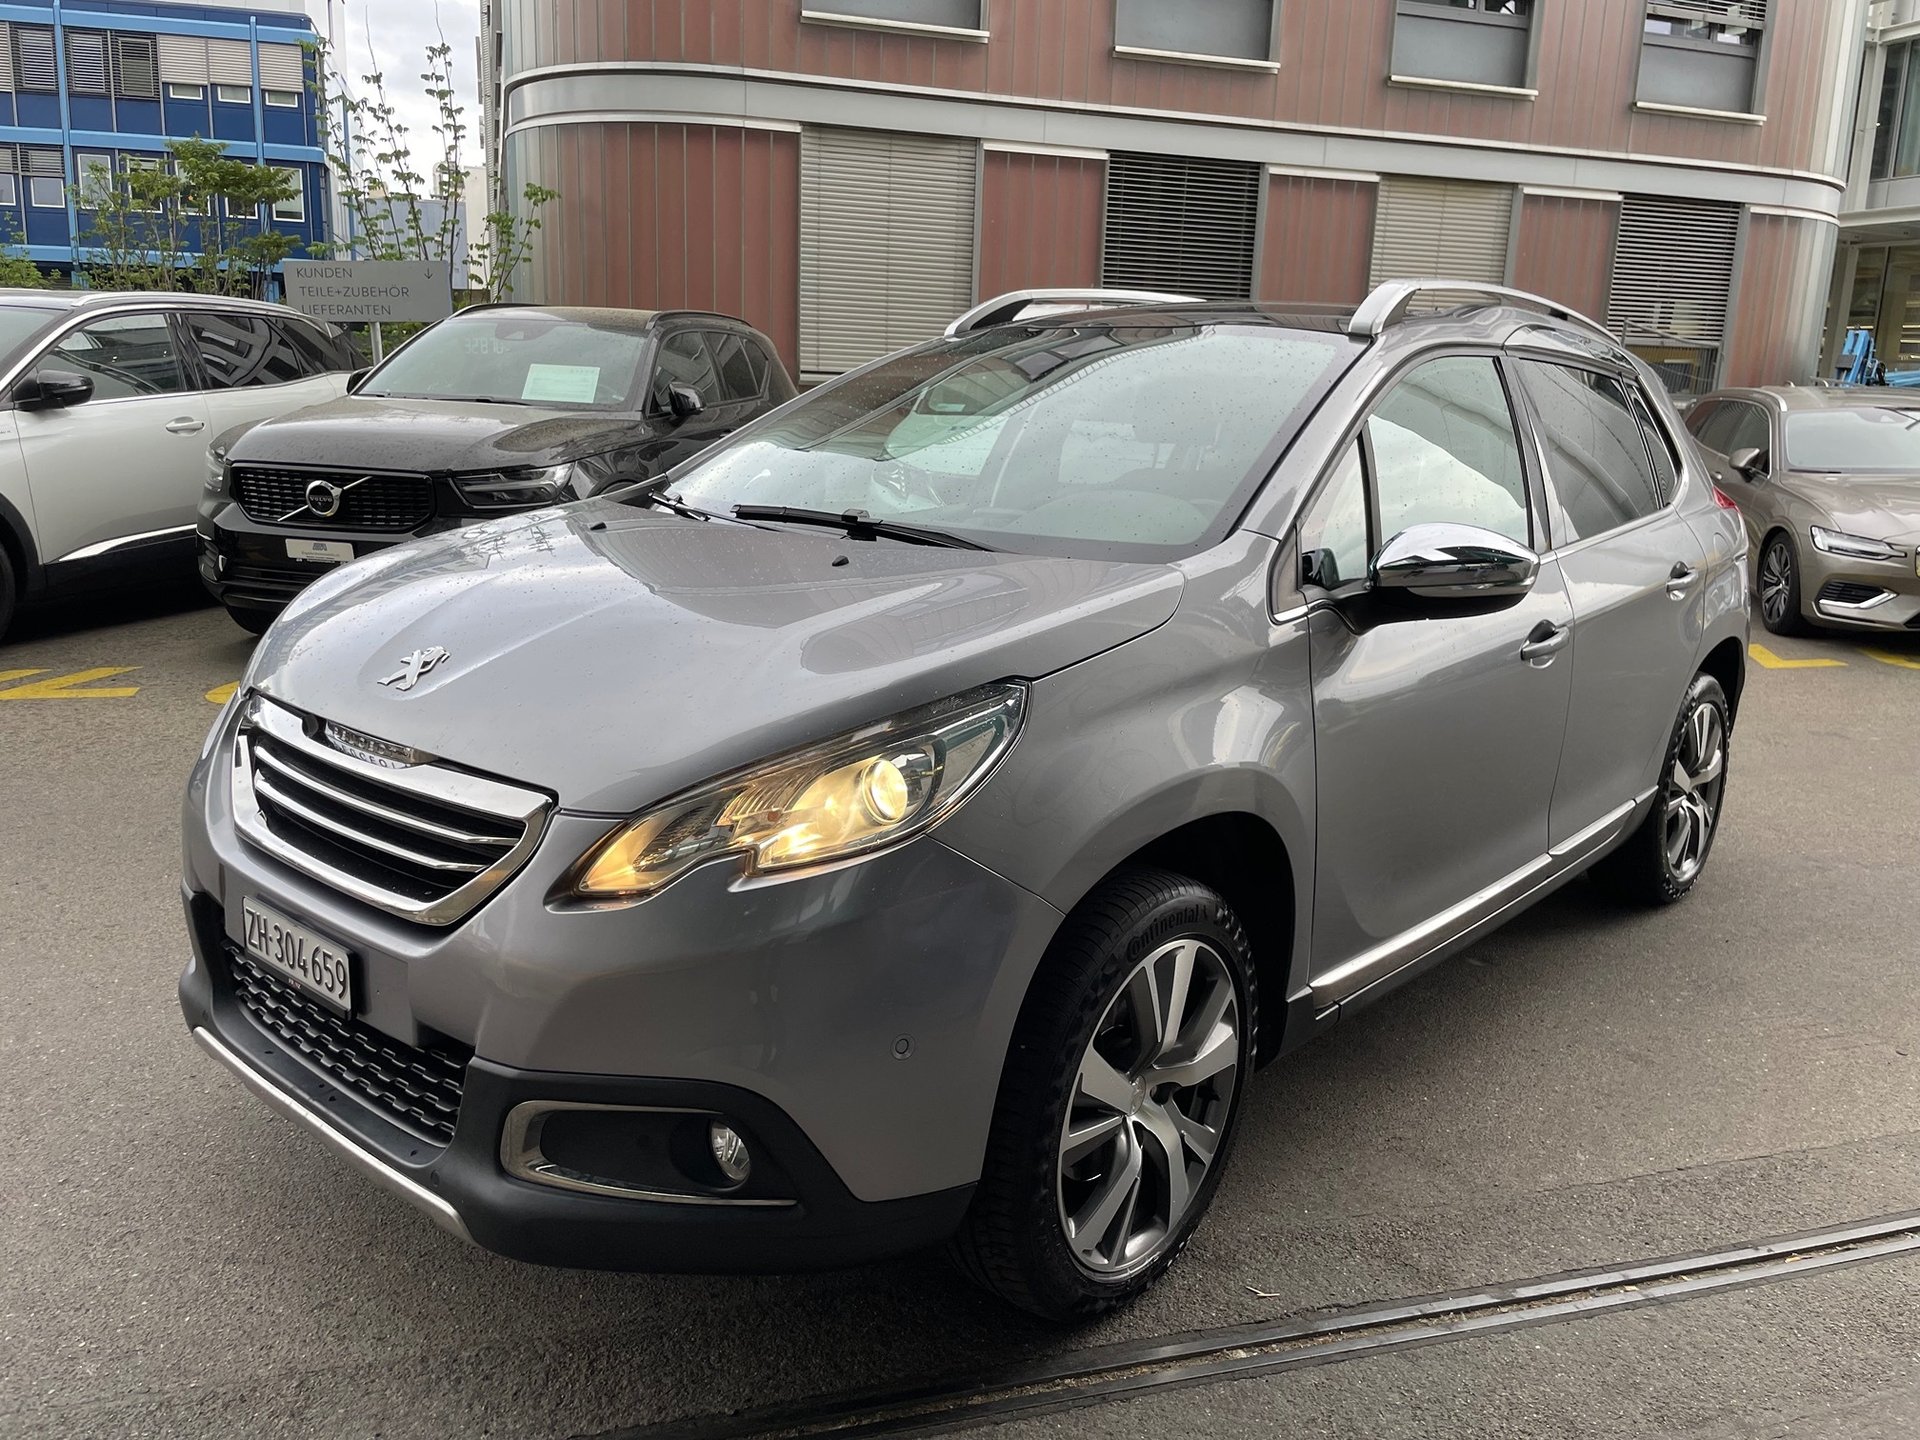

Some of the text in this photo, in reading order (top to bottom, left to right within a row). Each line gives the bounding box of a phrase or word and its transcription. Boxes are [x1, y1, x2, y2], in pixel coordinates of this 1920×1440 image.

[296, 267, 353, 279] KUNDEN
[299, 284, 410, 298] TEILE+ZUBEHÖR
[301, 304, 392, 316] LIEFERANTEN
[1126, 904, 1199, 962] Continental
